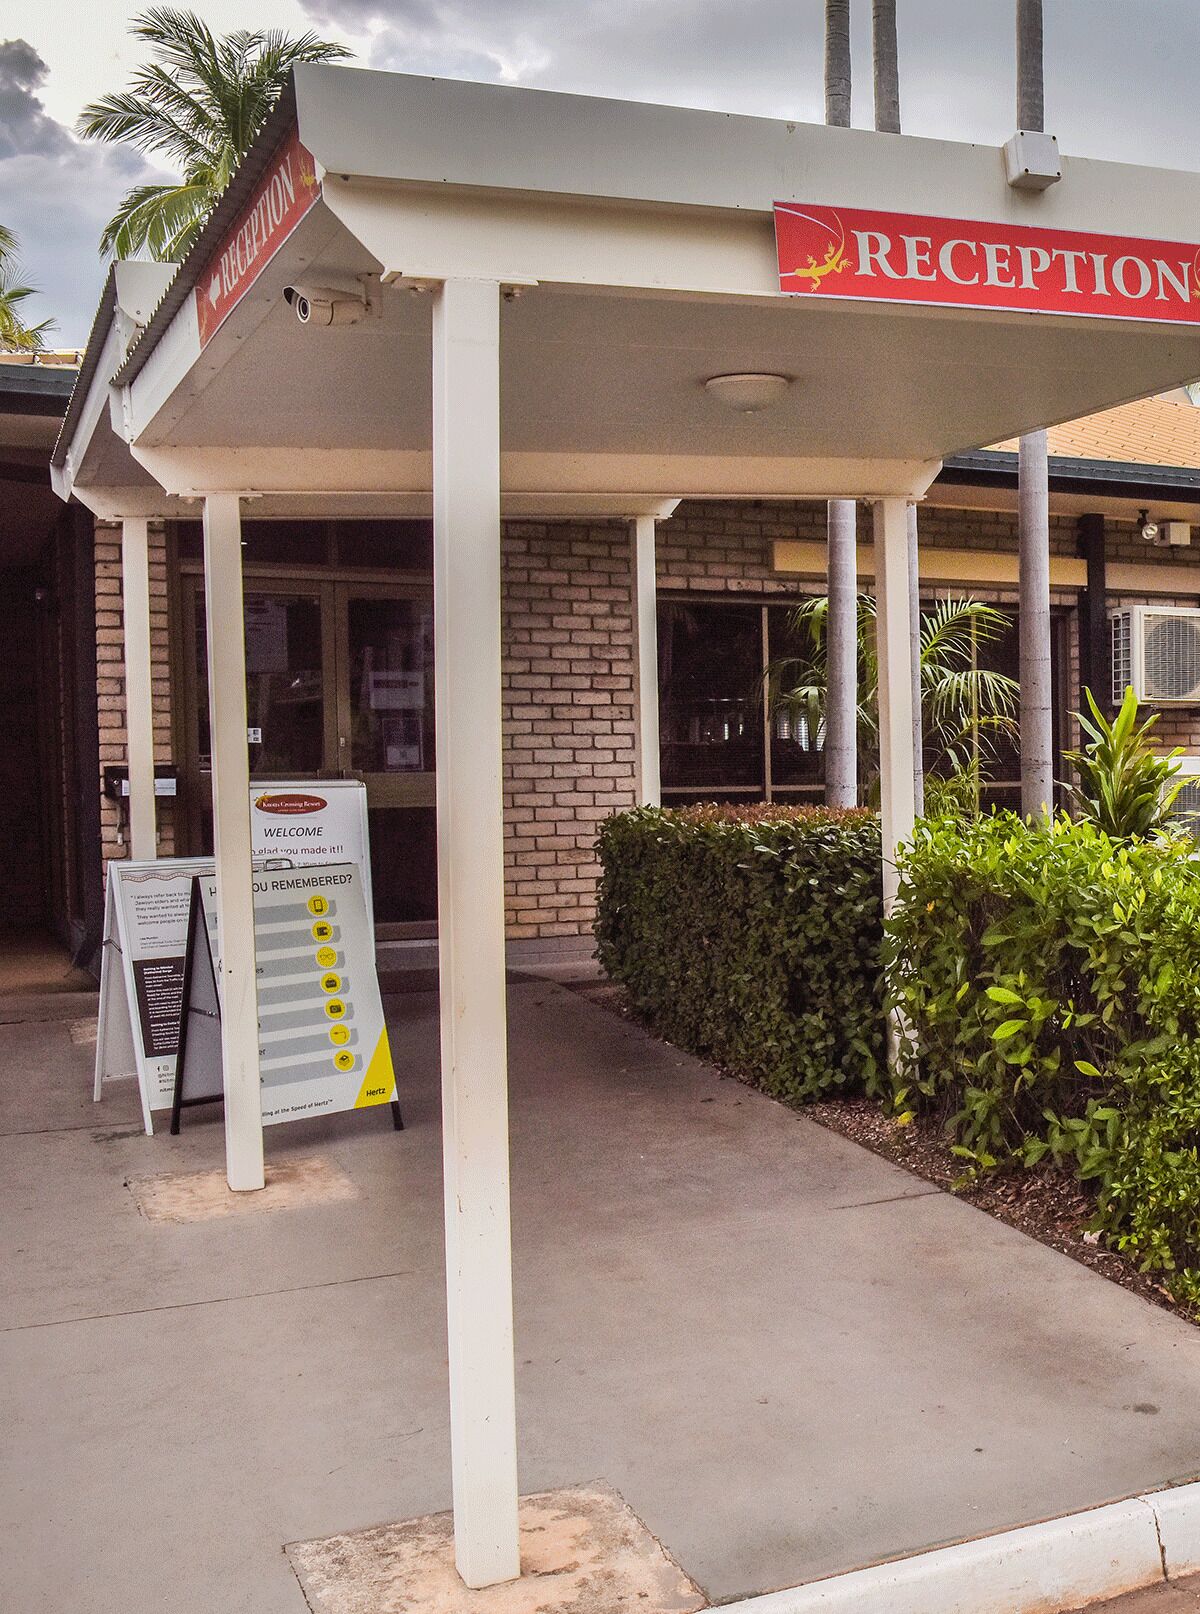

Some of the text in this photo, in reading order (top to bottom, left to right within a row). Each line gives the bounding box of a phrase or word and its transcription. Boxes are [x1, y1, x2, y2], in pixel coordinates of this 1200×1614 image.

[220, 152, 296, 299] RECEPTION
[850, 229, 1192, 303] RECEPTION
[264, 826, 324, 838] WELCOME
[301, 845, 327, 855] made
[252, 873, 353, 893] OU REMEMBERED?
[366, 1087, 386, 1097] Hertz
[291, 1104, 307, 1112] Speed
